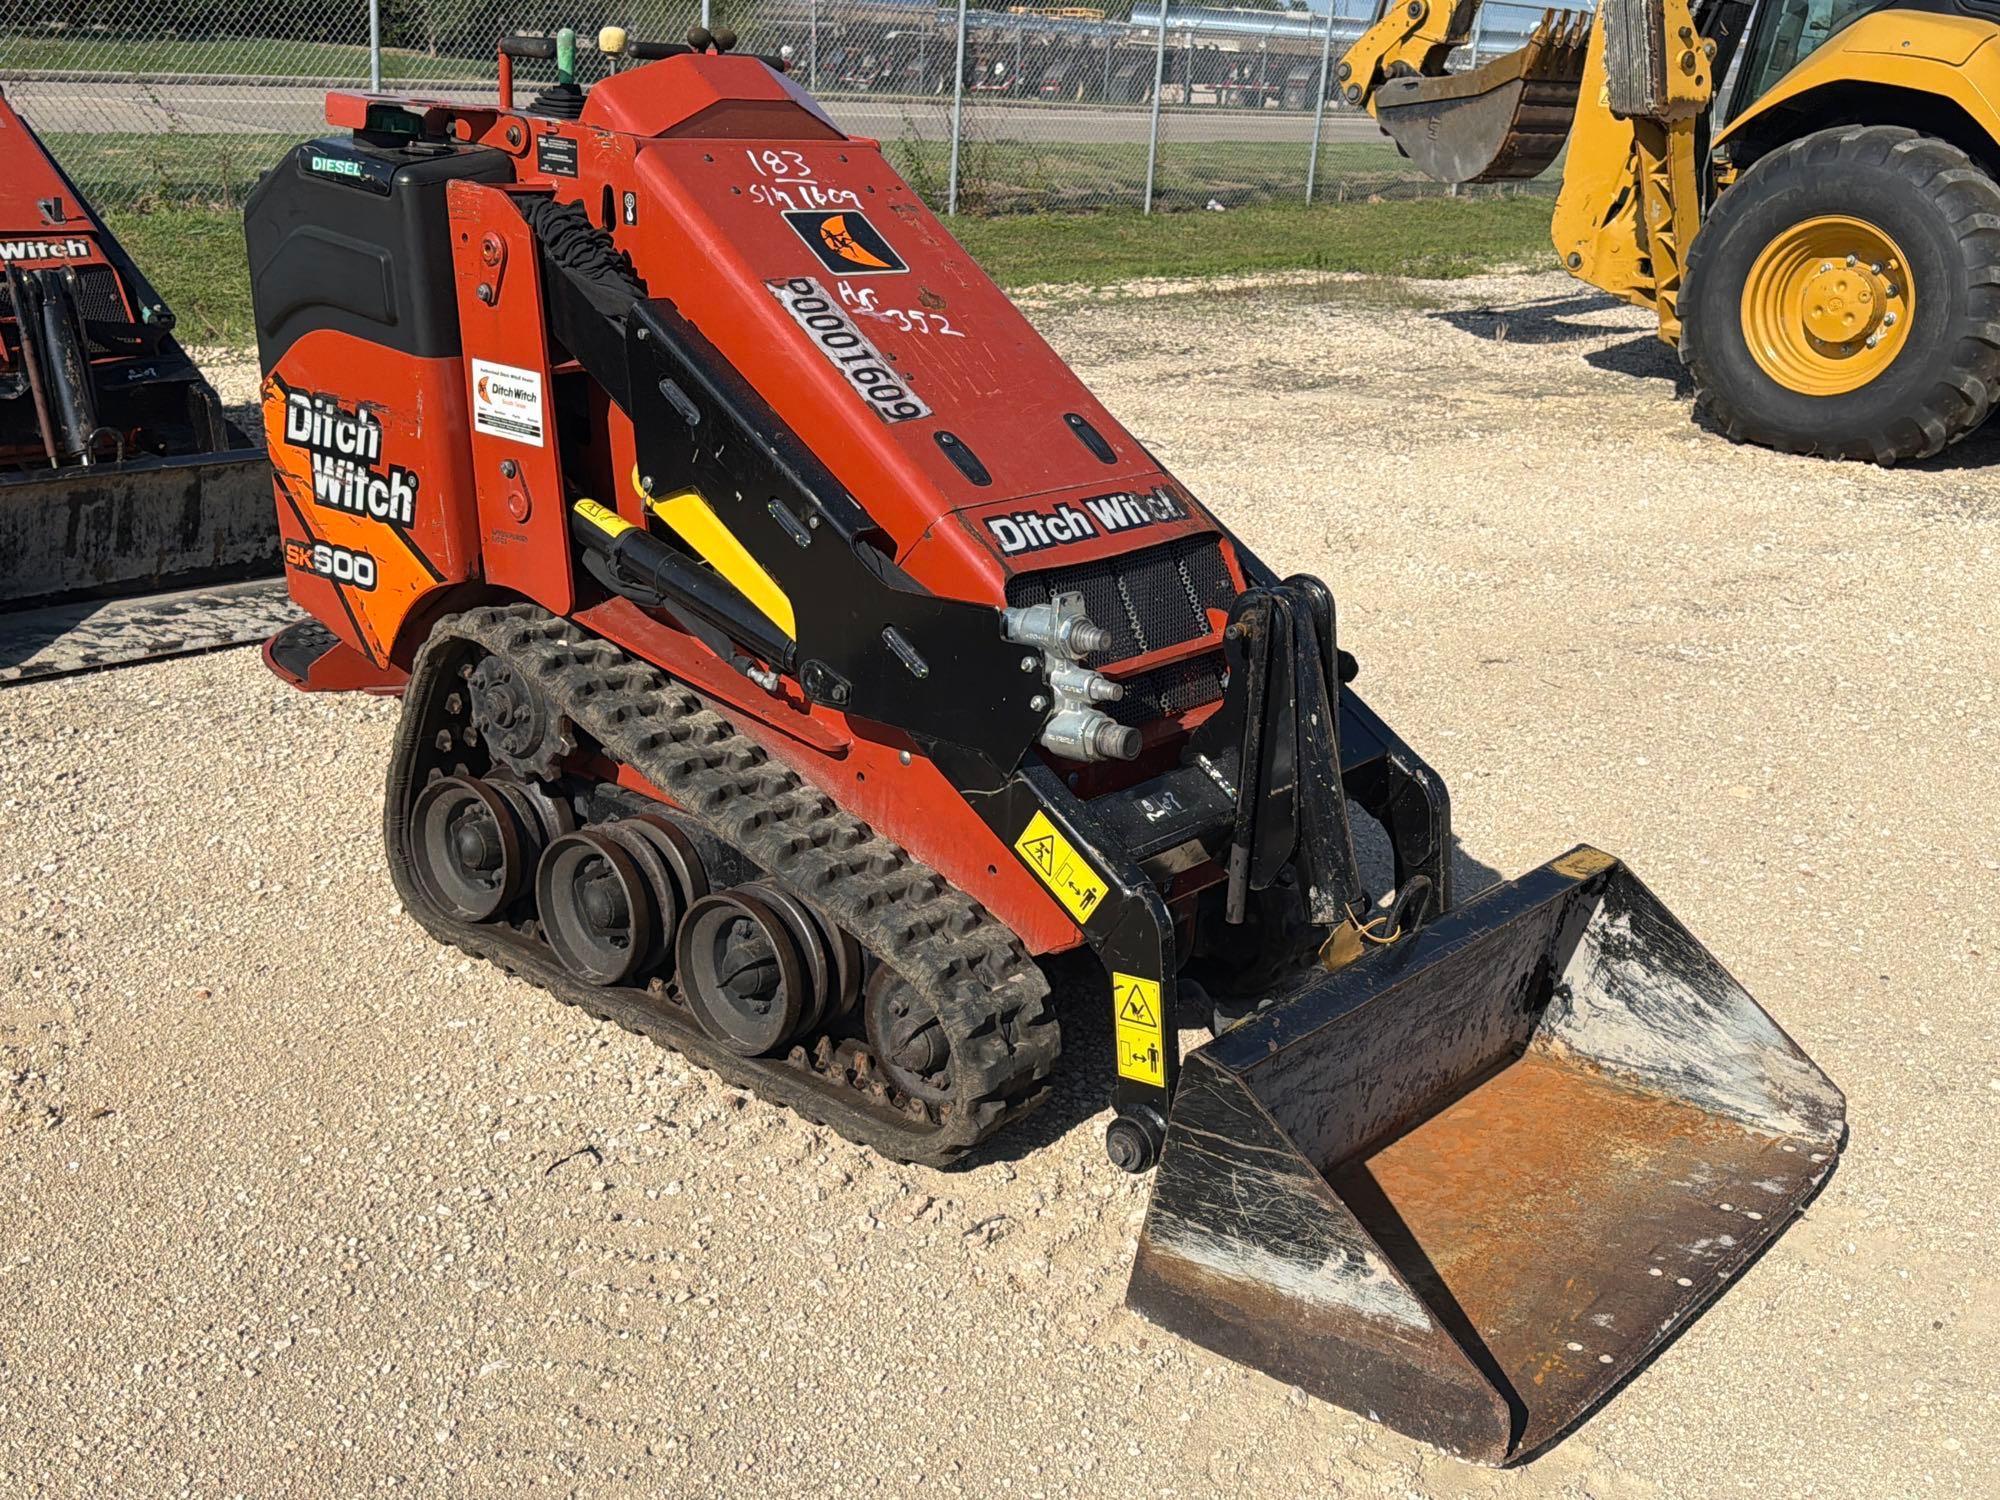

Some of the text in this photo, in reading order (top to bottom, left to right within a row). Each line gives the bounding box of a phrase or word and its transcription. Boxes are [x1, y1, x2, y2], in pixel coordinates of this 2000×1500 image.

[312, 156, 361, 177] DIESEL
[747, 150, 811, 177] 183
[798, 186, 864, 210] 1609
[0, 240, 88, 260] Witch
[884, 309, 965, 337] 352
[492, 383, 537, 403] Ditch Witch
[287, 393, 379, 459] Ditch
[989, 507, 1095, 553] Ditch
